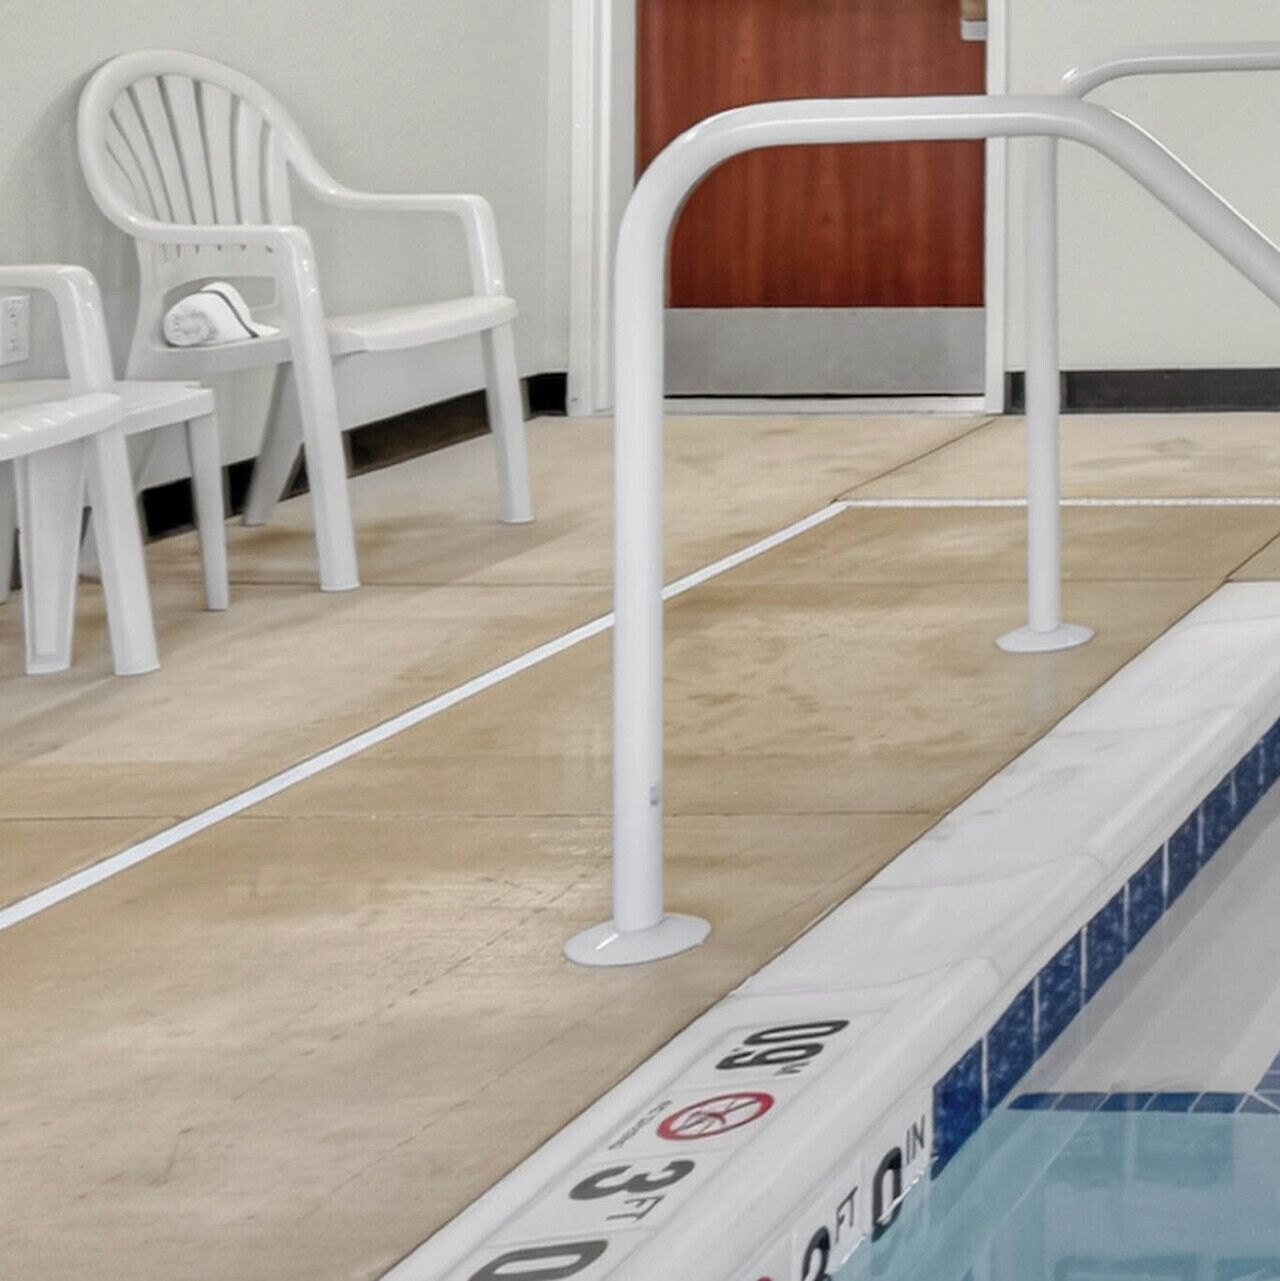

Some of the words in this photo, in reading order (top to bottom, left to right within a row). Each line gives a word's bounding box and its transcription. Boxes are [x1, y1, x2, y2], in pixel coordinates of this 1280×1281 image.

[569, 1160, 696, 1200] 3
[836, 1185, 858, 1243] FT
[871, 1146, 902, 1242] 0
[906, 1114, 925, 1164] IN
[606, 1195, 666, 1222] FT
[467, 1239, 609, 1281] 0
